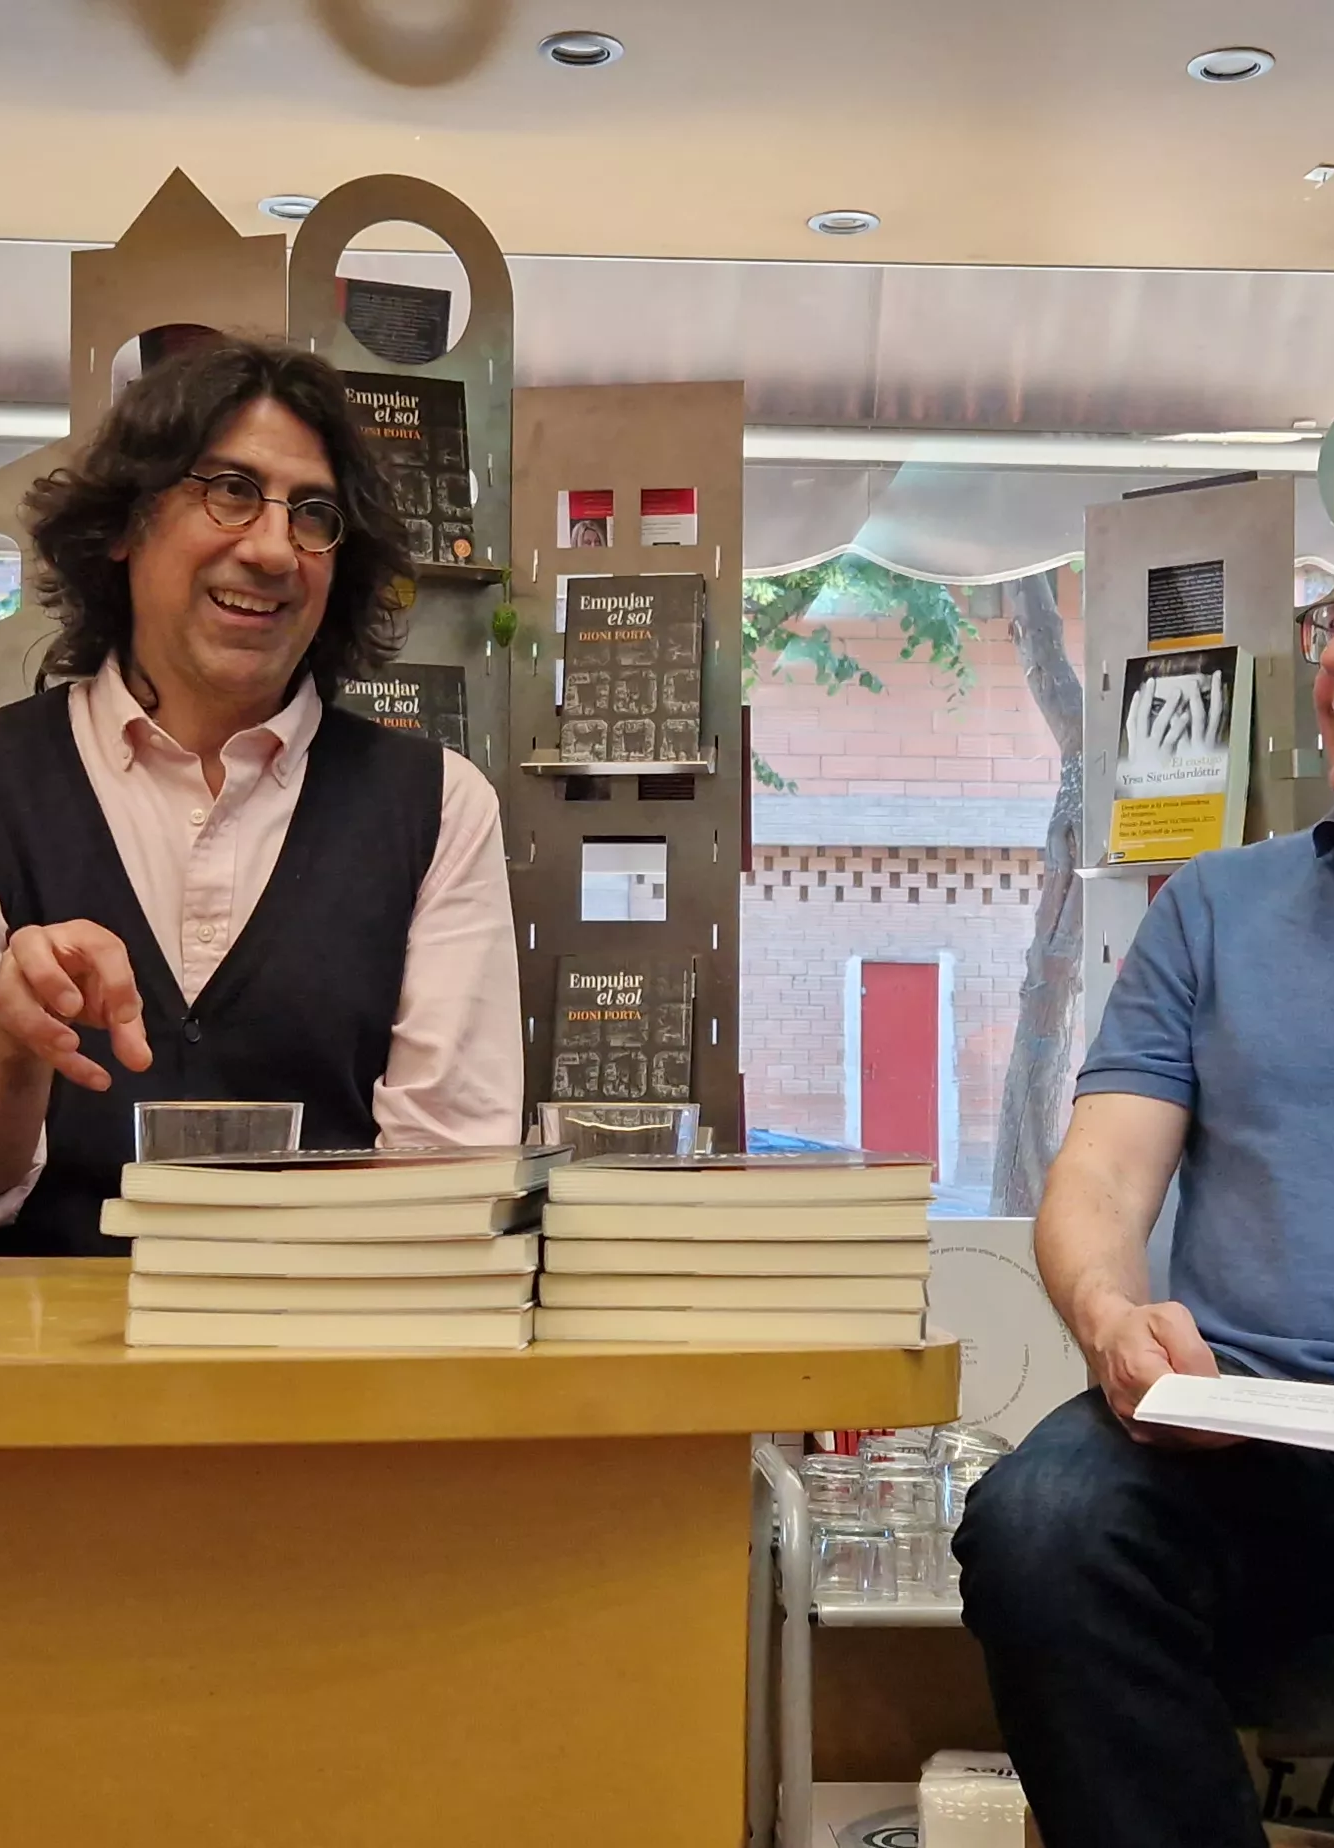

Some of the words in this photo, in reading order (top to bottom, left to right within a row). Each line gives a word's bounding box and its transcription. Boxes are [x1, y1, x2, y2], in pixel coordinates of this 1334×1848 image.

[344, 387, 420, 409] Empujar
[374, 407, 391, 423] el
[394, 409, 420, 426] sol
[384, 427, 422, 441] PORTA
[580, 593, 654, 612] Empujar
[607, 610, 623, 626] el
[627, 609, 653, 626] sol
[579, 630, 612, 642] DIONI
[614, 629, 653, 641] PORTA
[344, 678, 420, 699] Empujar
[374, 696, 391, 713] el
[394, 697, 420, 714] sol
[383, 717, 422, 729] PORTA
[1171, 757, 1183, 768] El
[1122, 774, 1144, 787] Yrsa
[569, 971, 644, 991] Empujar
[596, 989, 613, 1006] el
[615, 989, 643, 1006] sol
[568, 1010, 602, 1021] DIONI
[604, 1009, 642, 1020] PORTA
